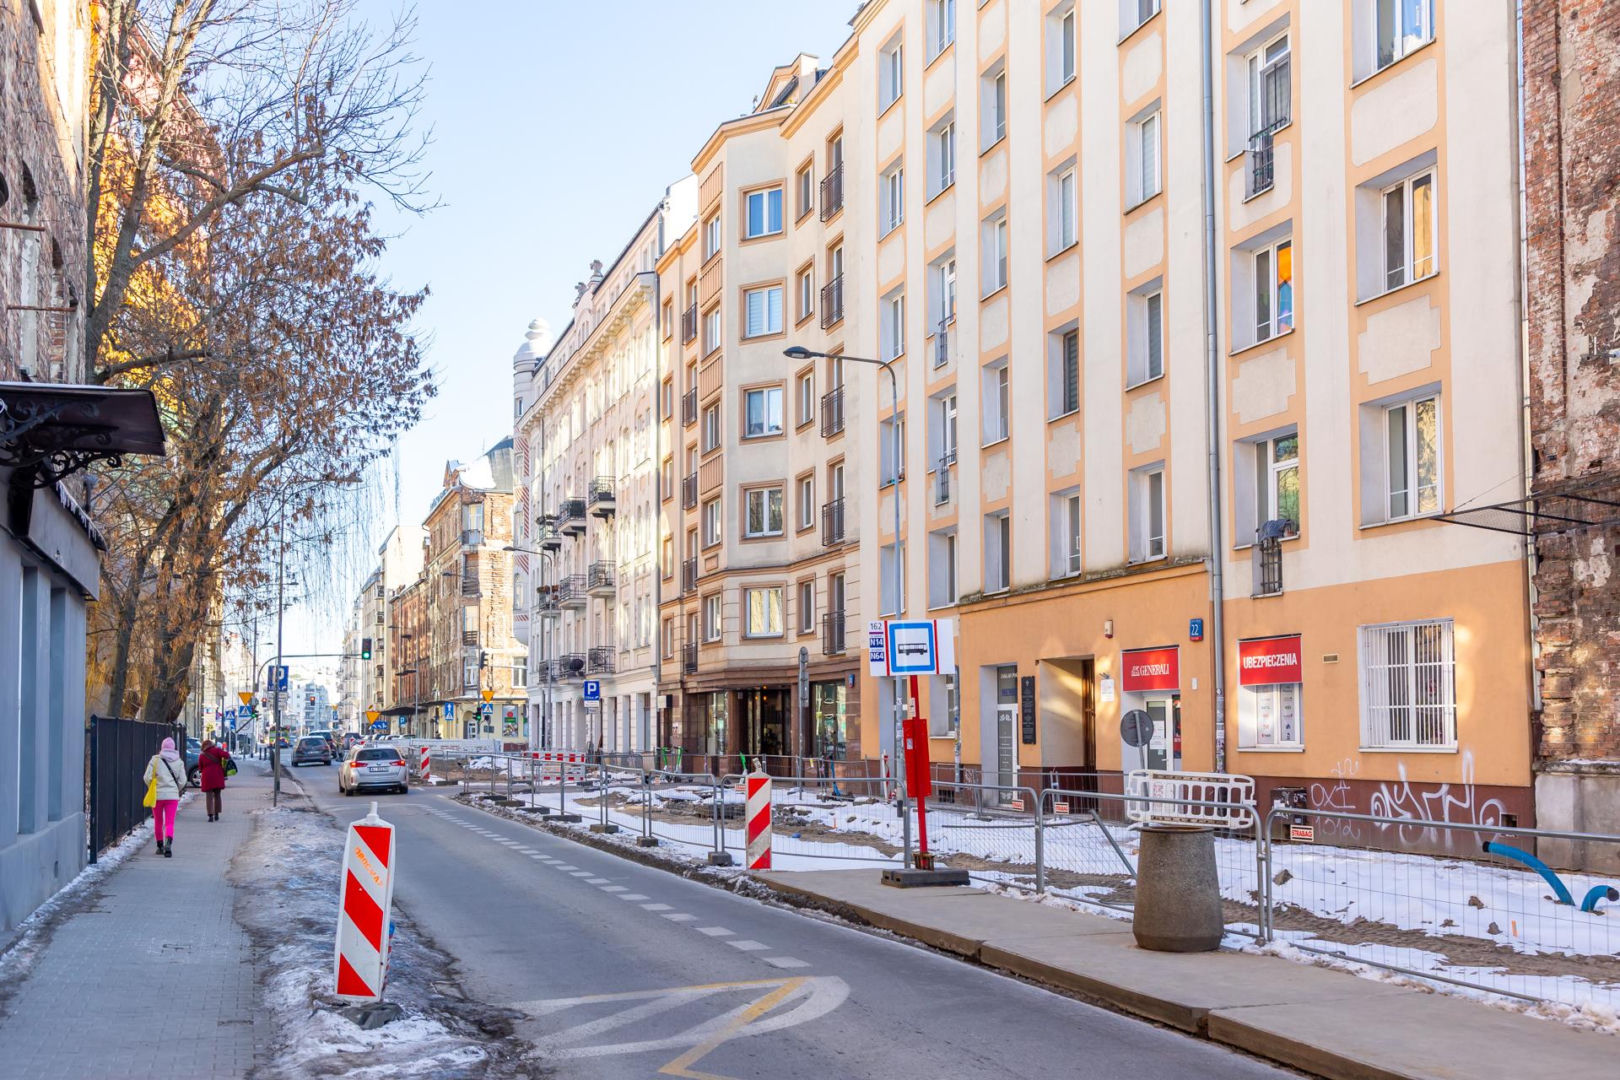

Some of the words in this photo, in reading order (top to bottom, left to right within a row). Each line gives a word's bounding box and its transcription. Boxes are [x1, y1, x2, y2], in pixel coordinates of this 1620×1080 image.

[870, 622, 882, 630] 162
[1191, 624, 1199, 636] 22
[870, 638, 883, 647] N14
[871, 652, 884, 660] N64
[1243, 652, 1298, 669] UBEZPIECZENIA
[1140, 663, 1170, 676] GENERALI
[587, 682, 597, 695] P
